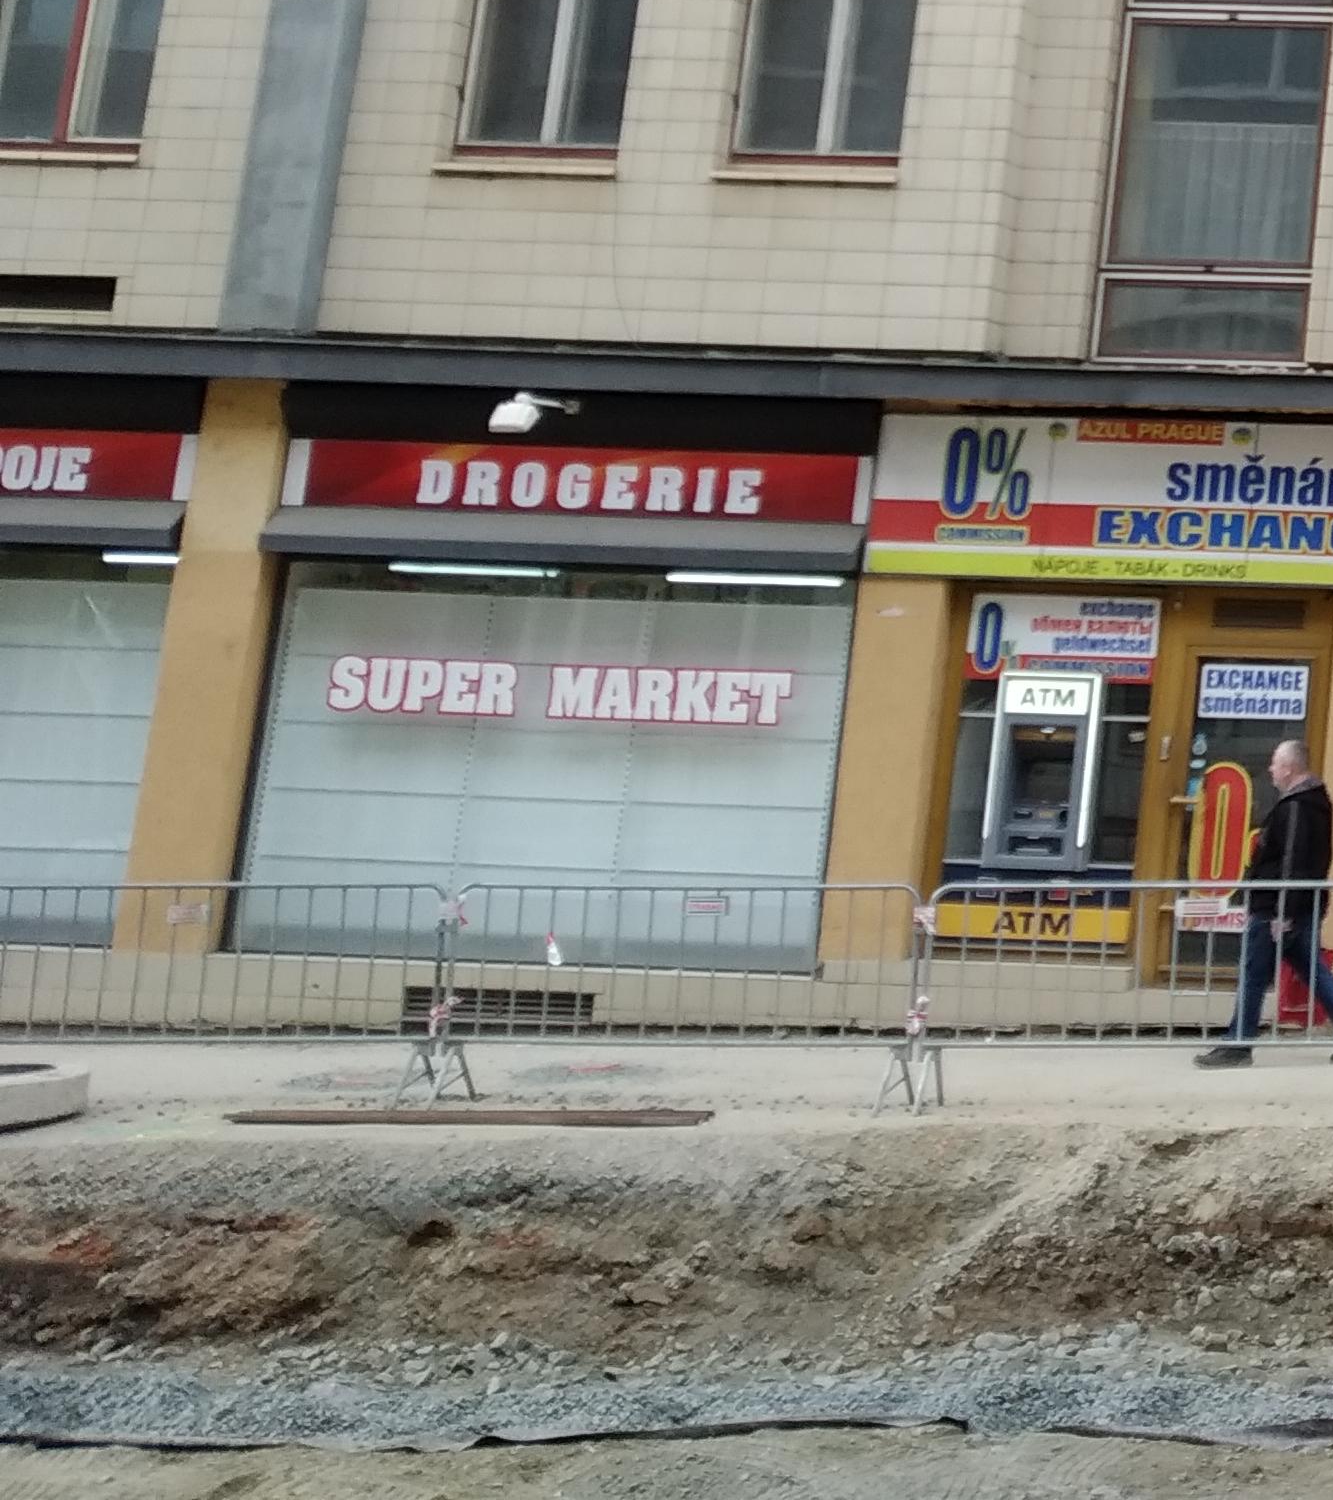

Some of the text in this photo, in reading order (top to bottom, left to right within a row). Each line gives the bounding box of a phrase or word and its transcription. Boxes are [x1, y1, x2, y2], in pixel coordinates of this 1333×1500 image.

[1079, 421, 1224, 442] AZUL PRAGUE
[0, 445, 92, 491] OJE
[943, 426, 1031, 518] 0%
[416, 458, 762, 515] DROGERIE
[1031, 557, 1099, 575] NÁPOJE
[1114, 558, 1169, 577] TABÁK
[1182, 563, 1247, 580] DRINKS
[328, 656, 517, 718] SUPER
[1206, 669, 1304, 690] EXCHANGE
[546, 666, 794, 727] MARKET
[1020, 687, 1076, 708] ATM
[1202, 691, 1302, 714] směnárna
[992, 911, 1072, 936] ATM
